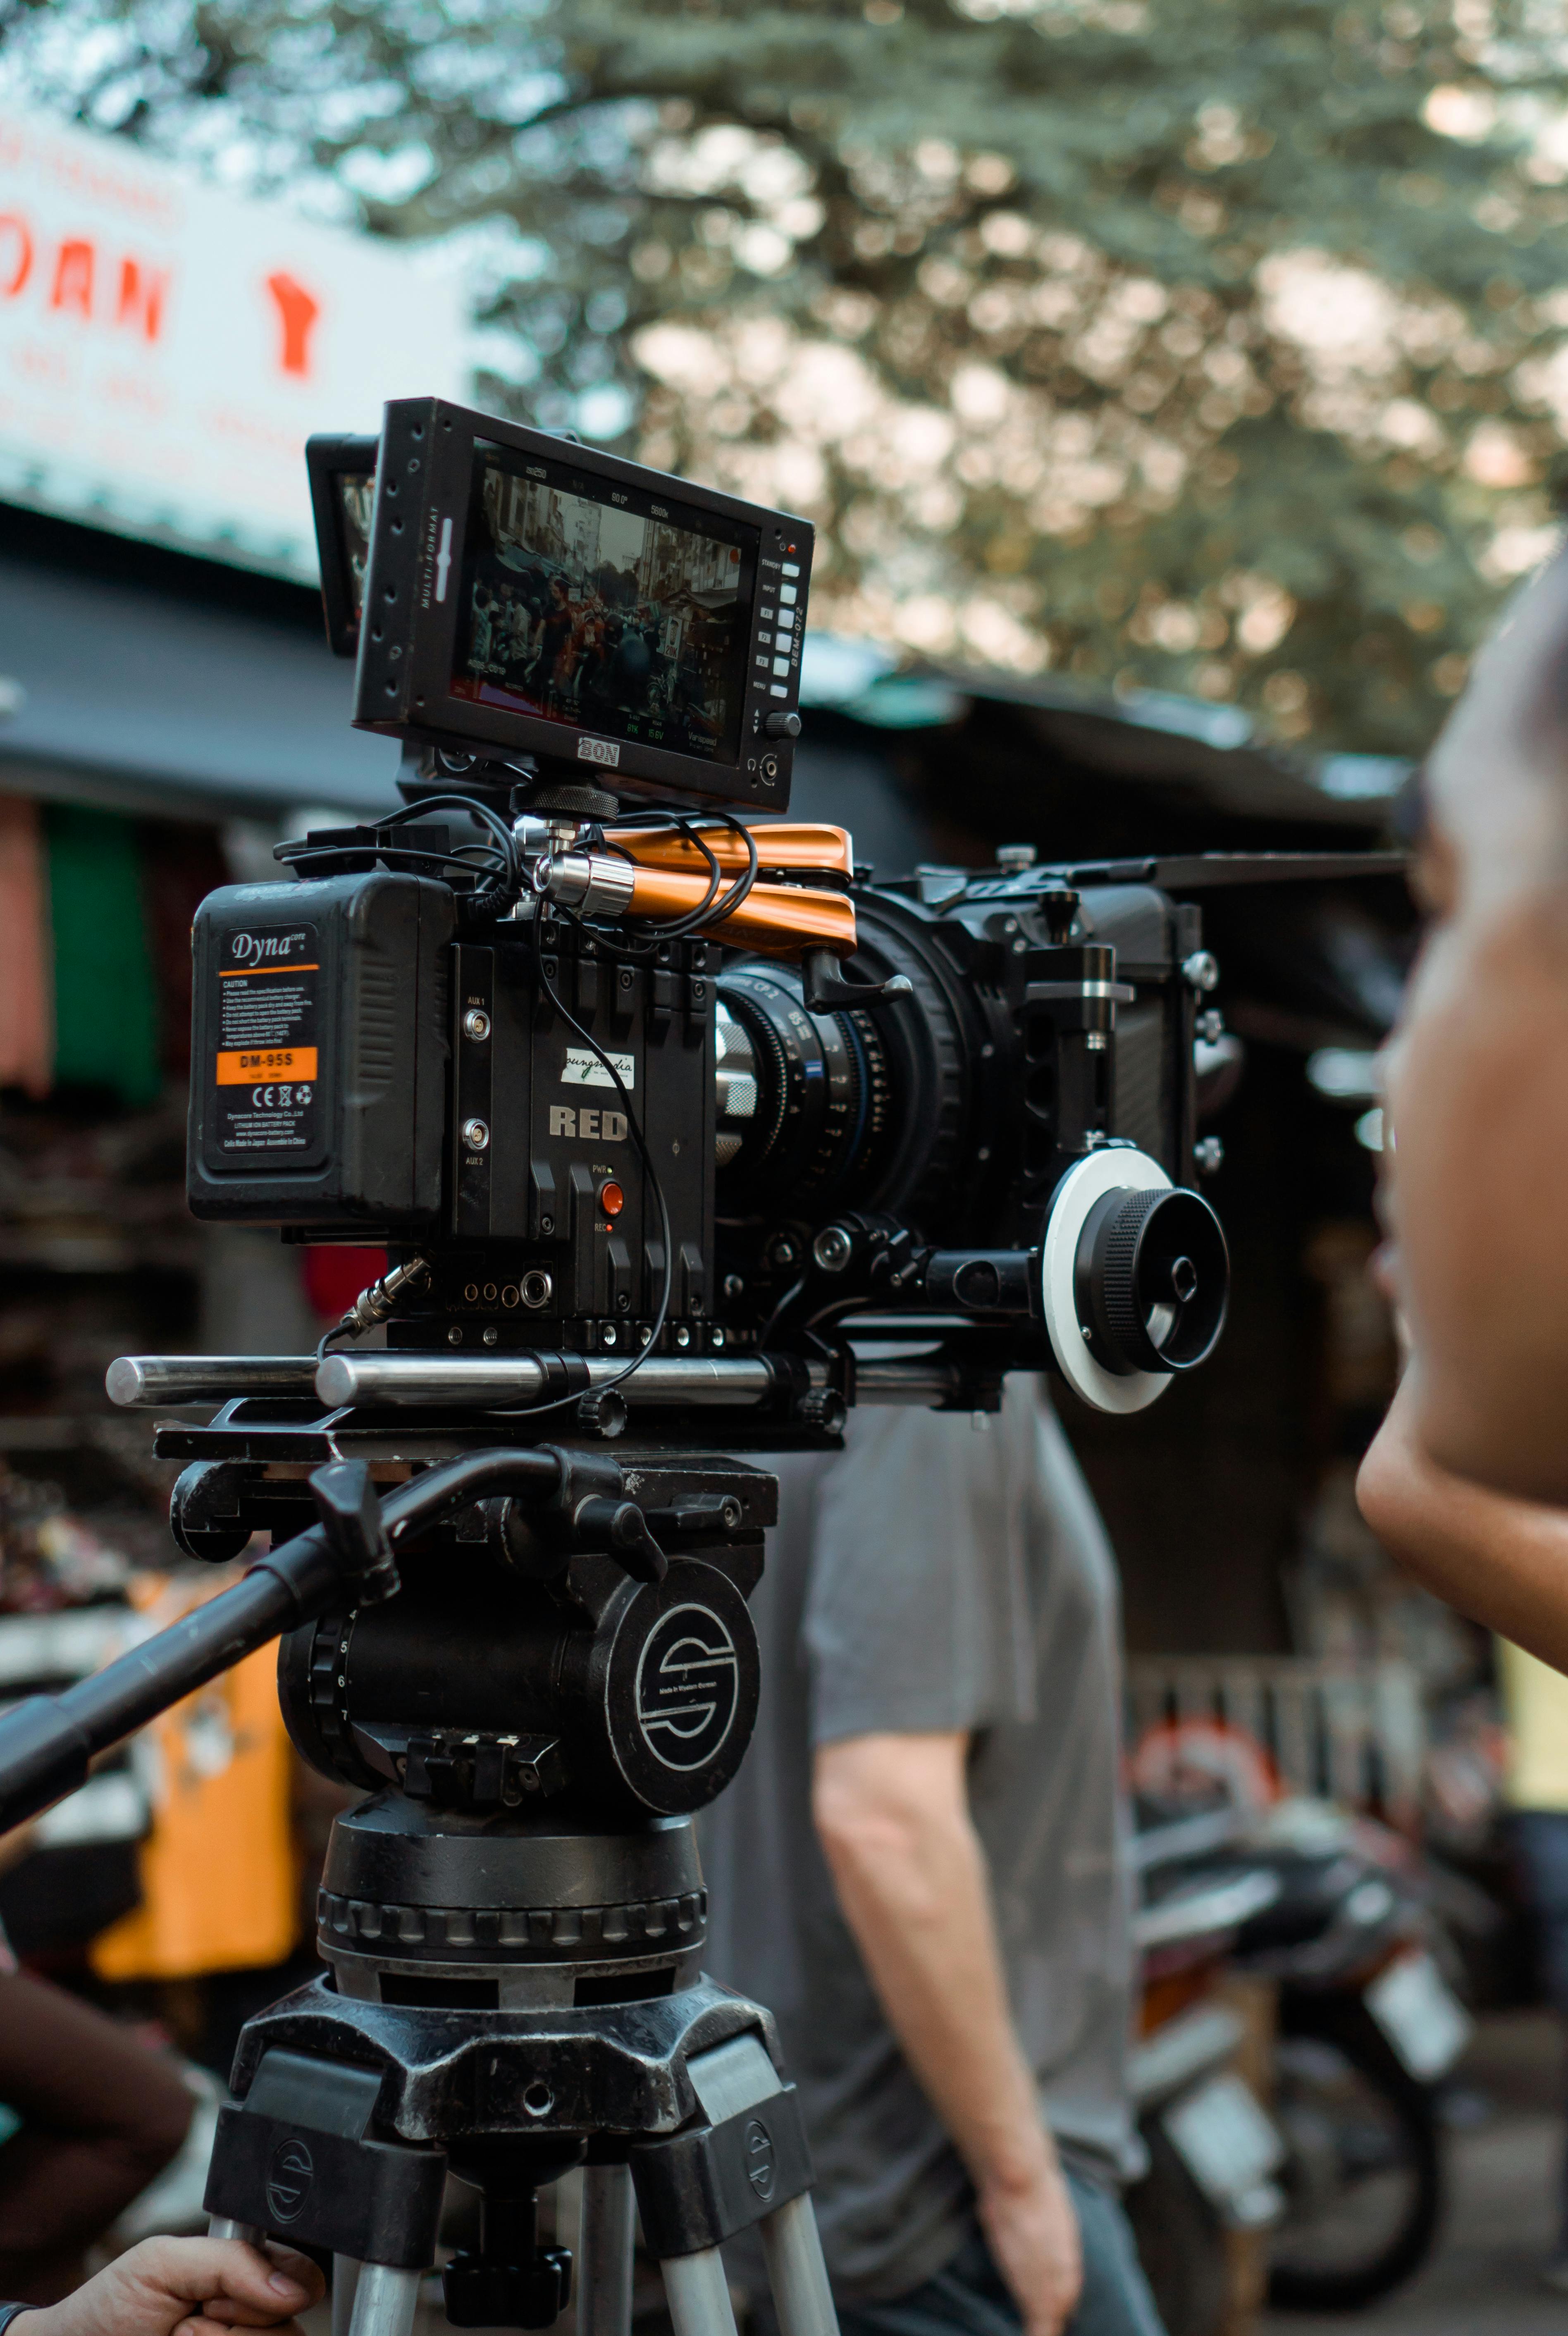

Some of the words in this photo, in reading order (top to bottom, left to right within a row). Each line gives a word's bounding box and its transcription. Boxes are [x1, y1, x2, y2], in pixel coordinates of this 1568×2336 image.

[421, 506, 438, 609] MULTI-FORMAT
[761, 558, 781, 570] STANDBY
[762, 584, 775, 594] INPUT
[791, 606, 804, 668] BEM-072
[753, 681, 766, 690] MENU
[627, 723, 639, 734] 81%
[688, 731, 716, 747] Varispeed
[580, 739, 618, 764] BON
[232, 933, 291, 966] Dyna
[223, 979, 248, 988] CAUTION
[468, 996, 480, 1005] AUX
[240, 1053, 293, 1068] DM-95S
[550, 1105, 628, 1141] RED
[593, 1165, 606, 1174] PWR
[594, 1223, 606, 1231] REC
[349, 1609, 358, 1620] 4
[340, 1641, 348, 1654] 5
[337, 1675, 345, 1688] 6
[341, 1709, 348, 1721] 7
